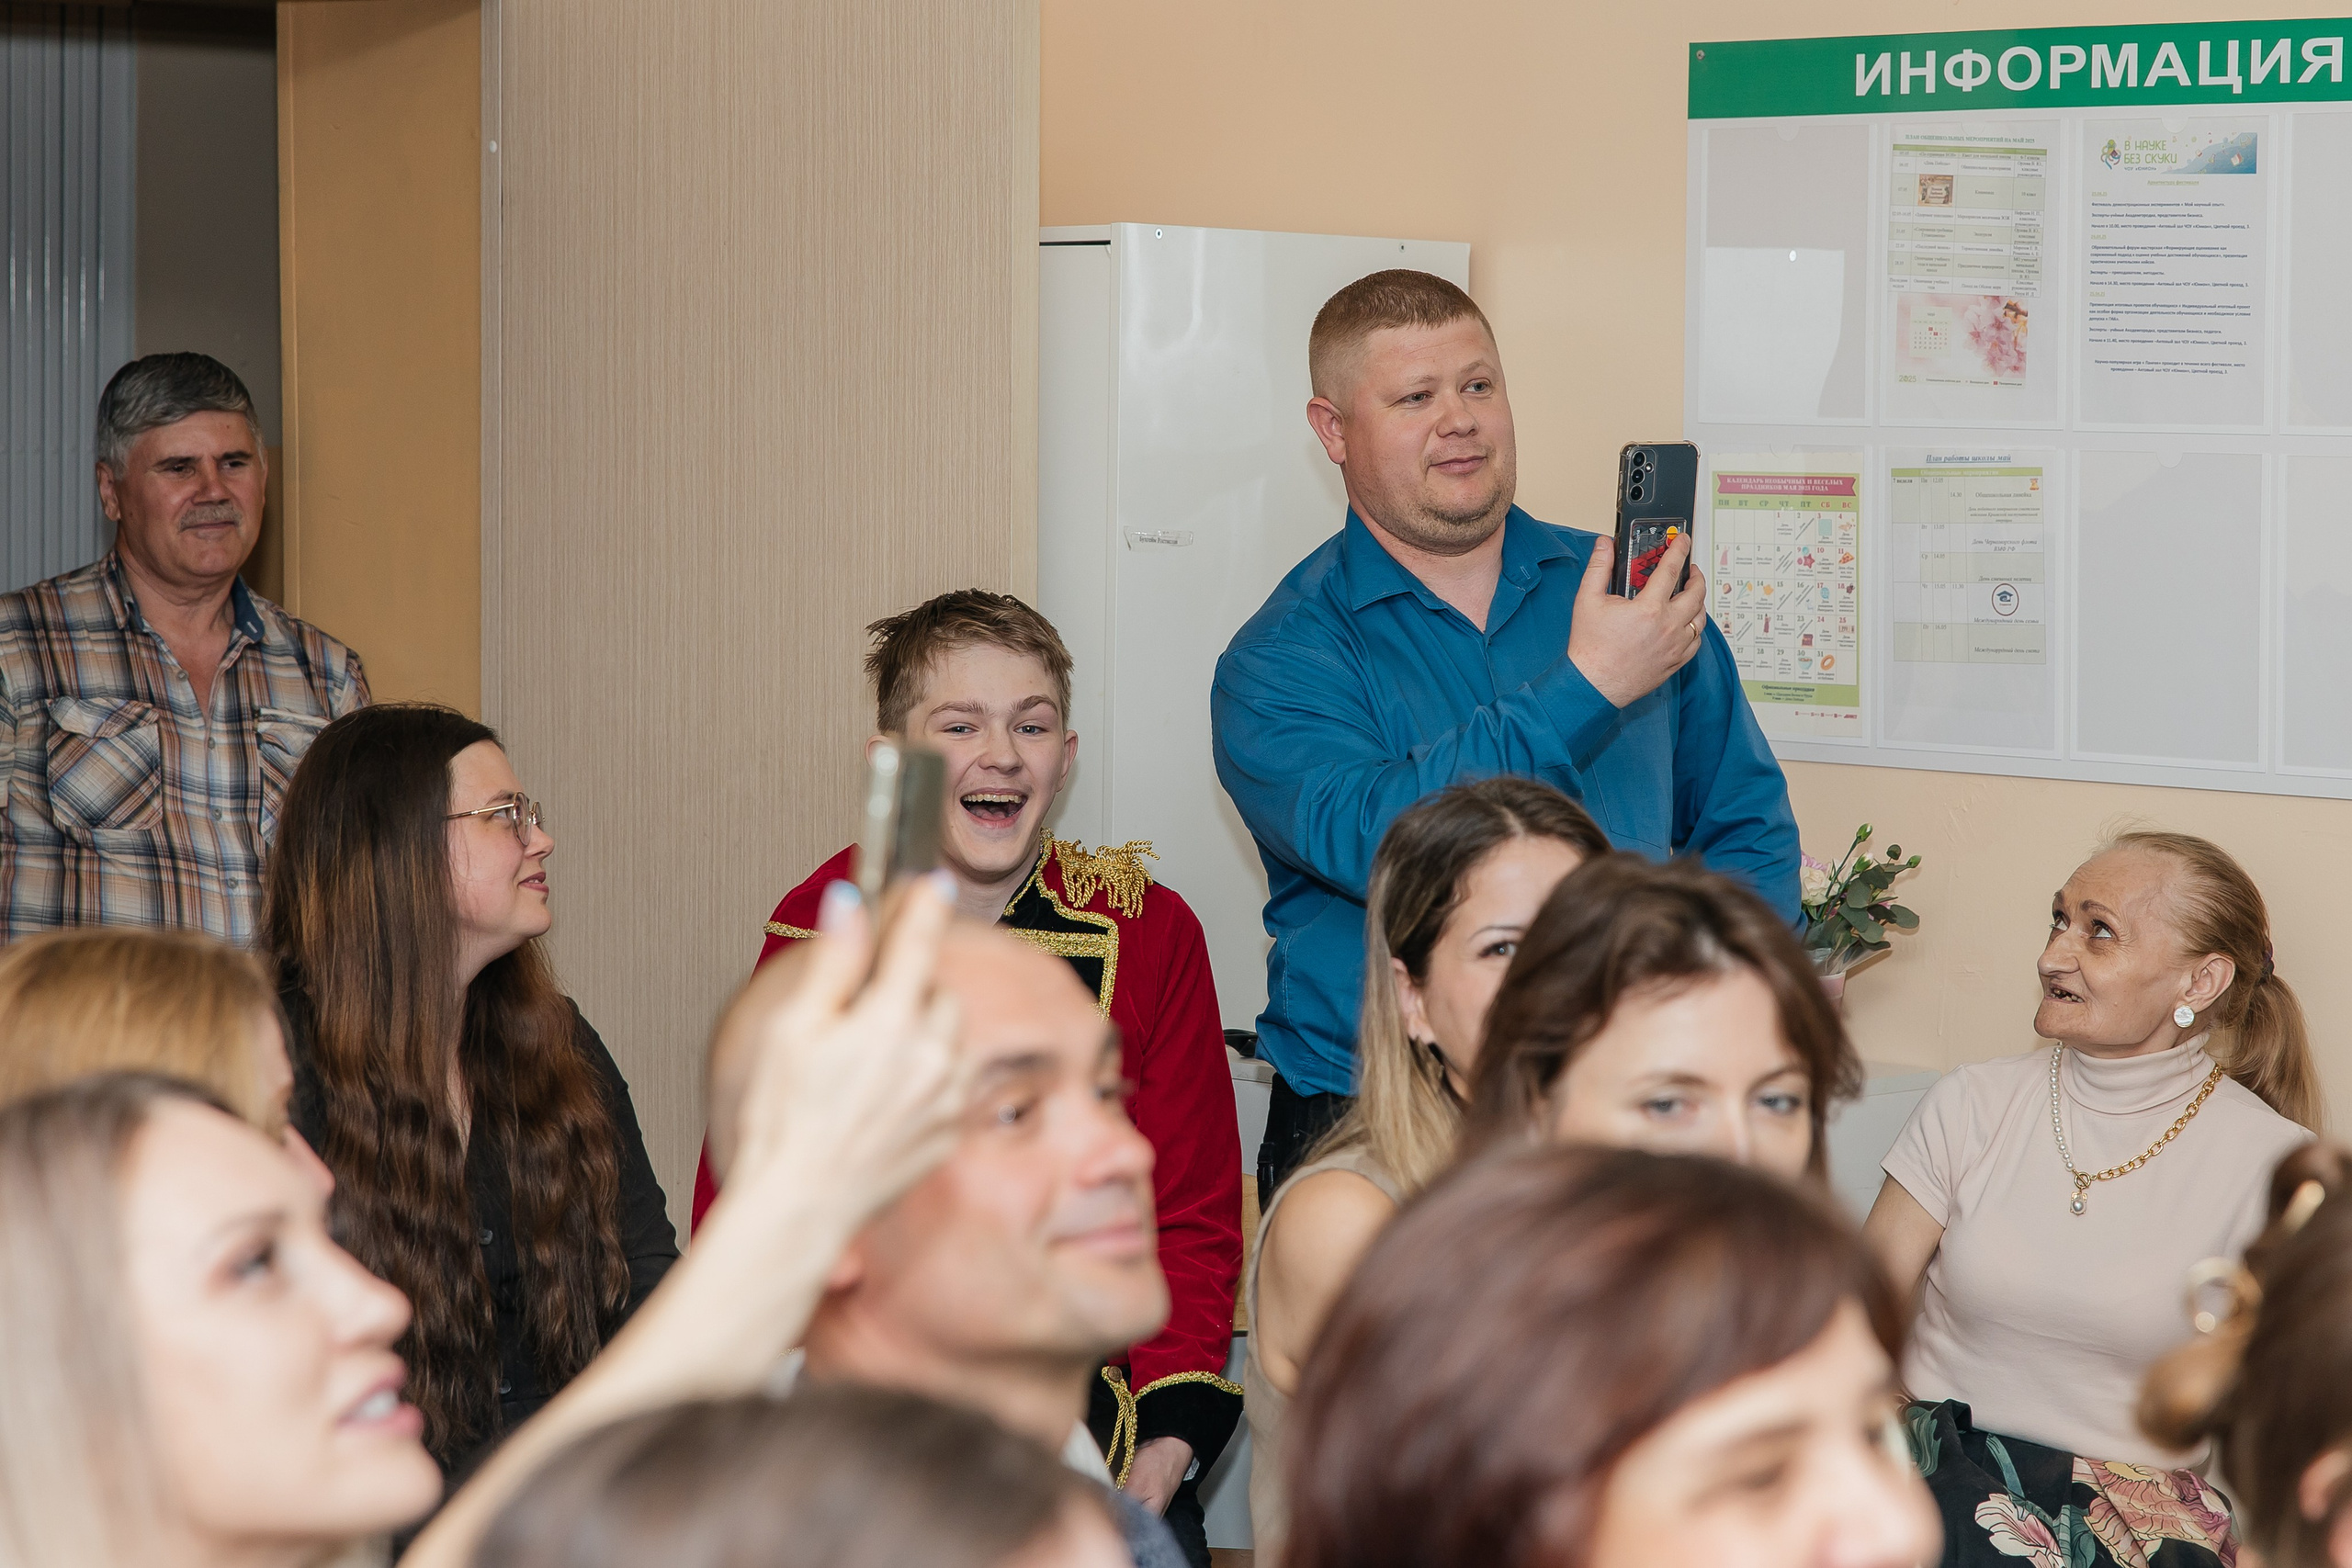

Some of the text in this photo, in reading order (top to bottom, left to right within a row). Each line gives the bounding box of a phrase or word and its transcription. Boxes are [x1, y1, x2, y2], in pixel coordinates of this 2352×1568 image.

[1855, 36, 2344, 96] ИНФОРМАЦИЯ
[2124, 141, 2166, 151] В НАУКЕ
[2124, 153, 2177, 164] БЕЗ СКУКИ
[1943, 455, 1970, 463] работы
